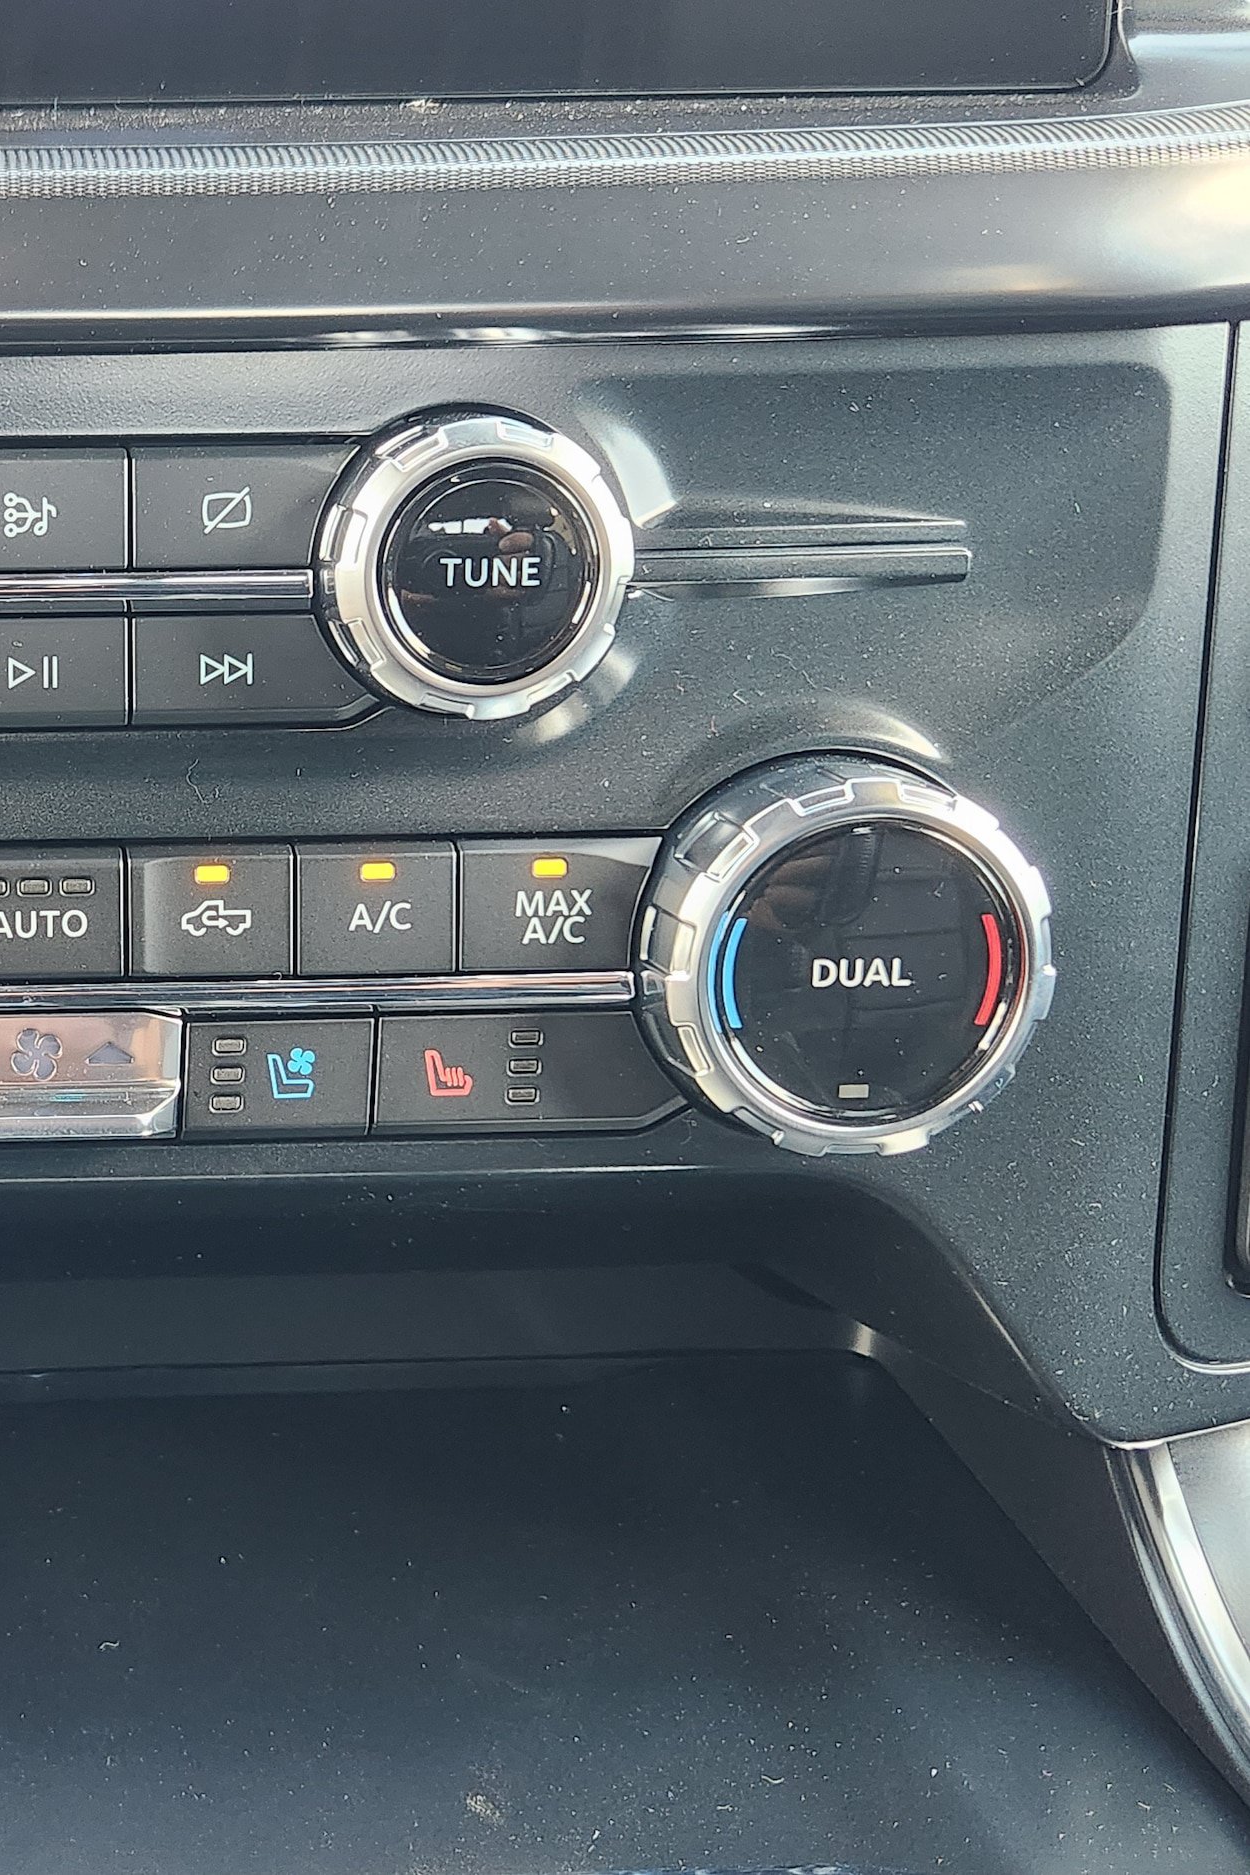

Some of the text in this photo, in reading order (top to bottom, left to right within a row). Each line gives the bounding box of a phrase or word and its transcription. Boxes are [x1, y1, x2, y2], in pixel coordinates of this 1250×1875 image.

[439, 556, 541, 588] TUNE
[348, 900, 413, 934] A/C
[514, 889, 593, 918] MAX
[521, 917, 586, 945] A/C
[810, 957, 912, 988] DUAL
